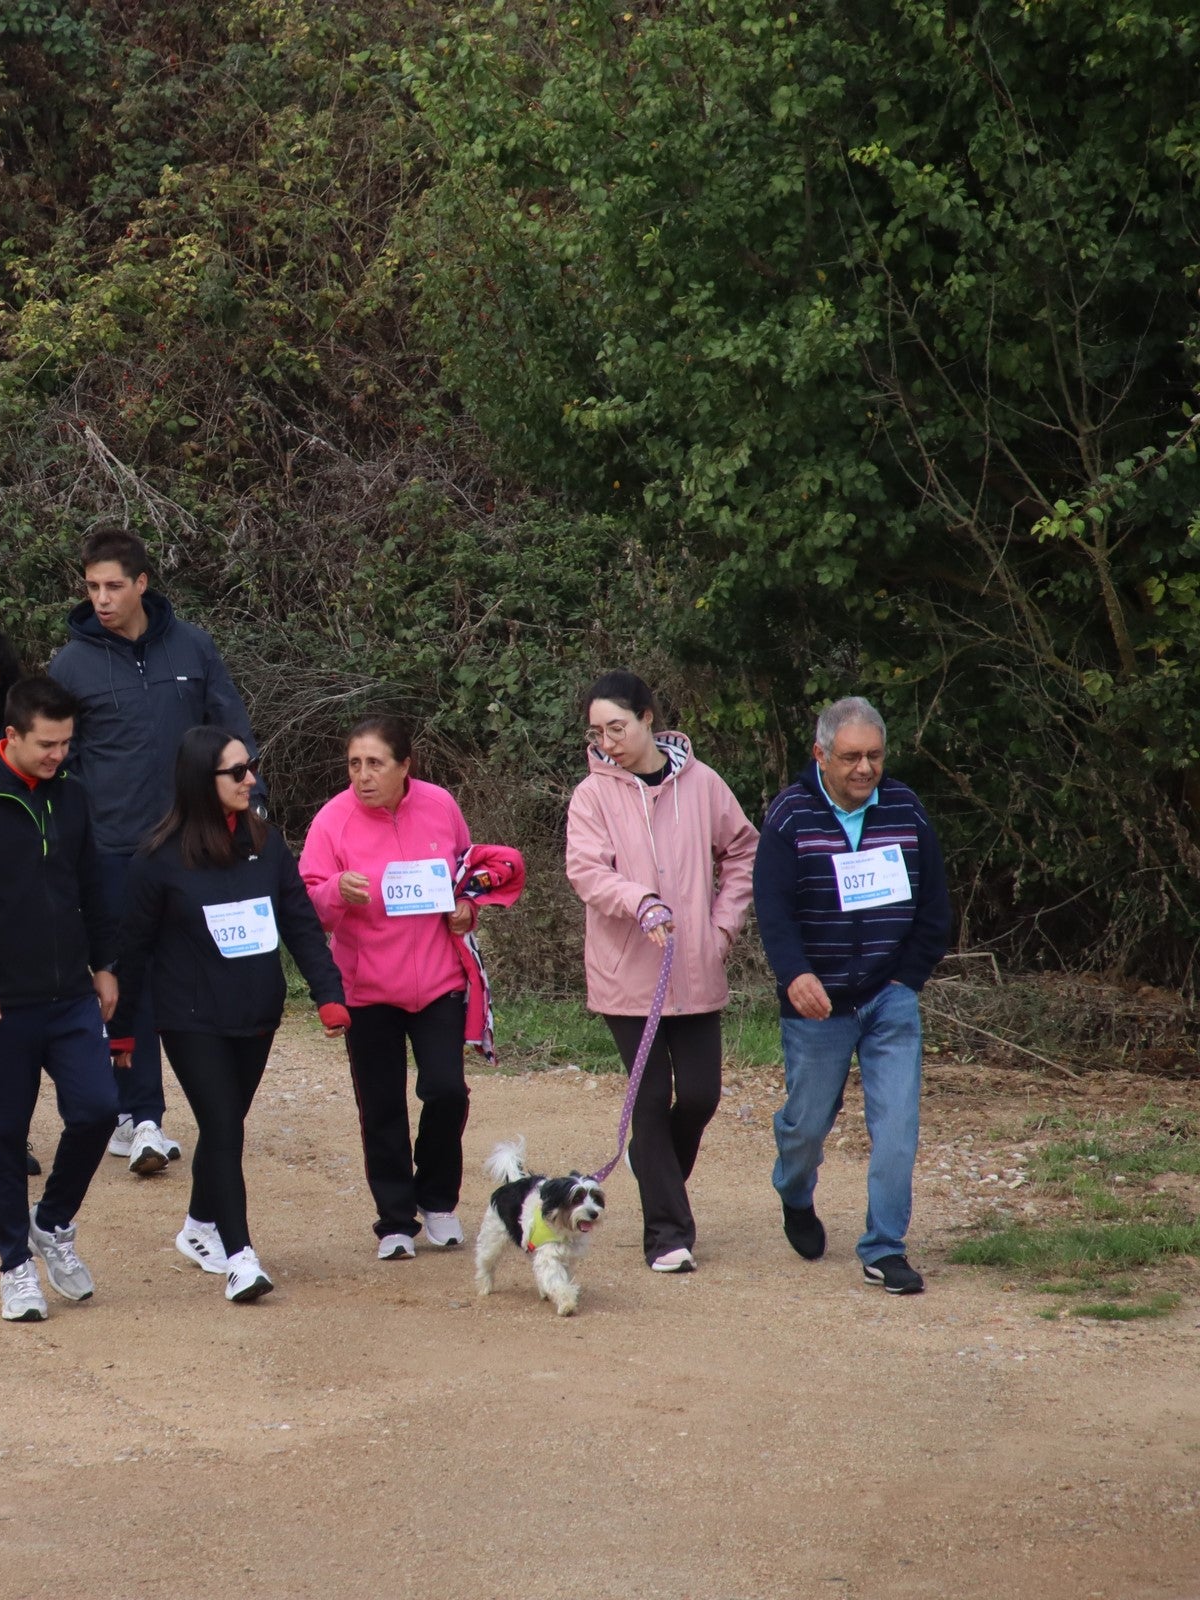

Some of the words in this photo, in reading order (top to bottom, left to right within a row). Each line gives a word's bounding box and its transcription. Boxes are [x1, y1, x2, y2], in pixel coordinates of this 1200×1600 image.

[844, 872, 875, 889] 0377
[387, 884, 422, 899] 0376
[213, 925, 246, 942] 0378
